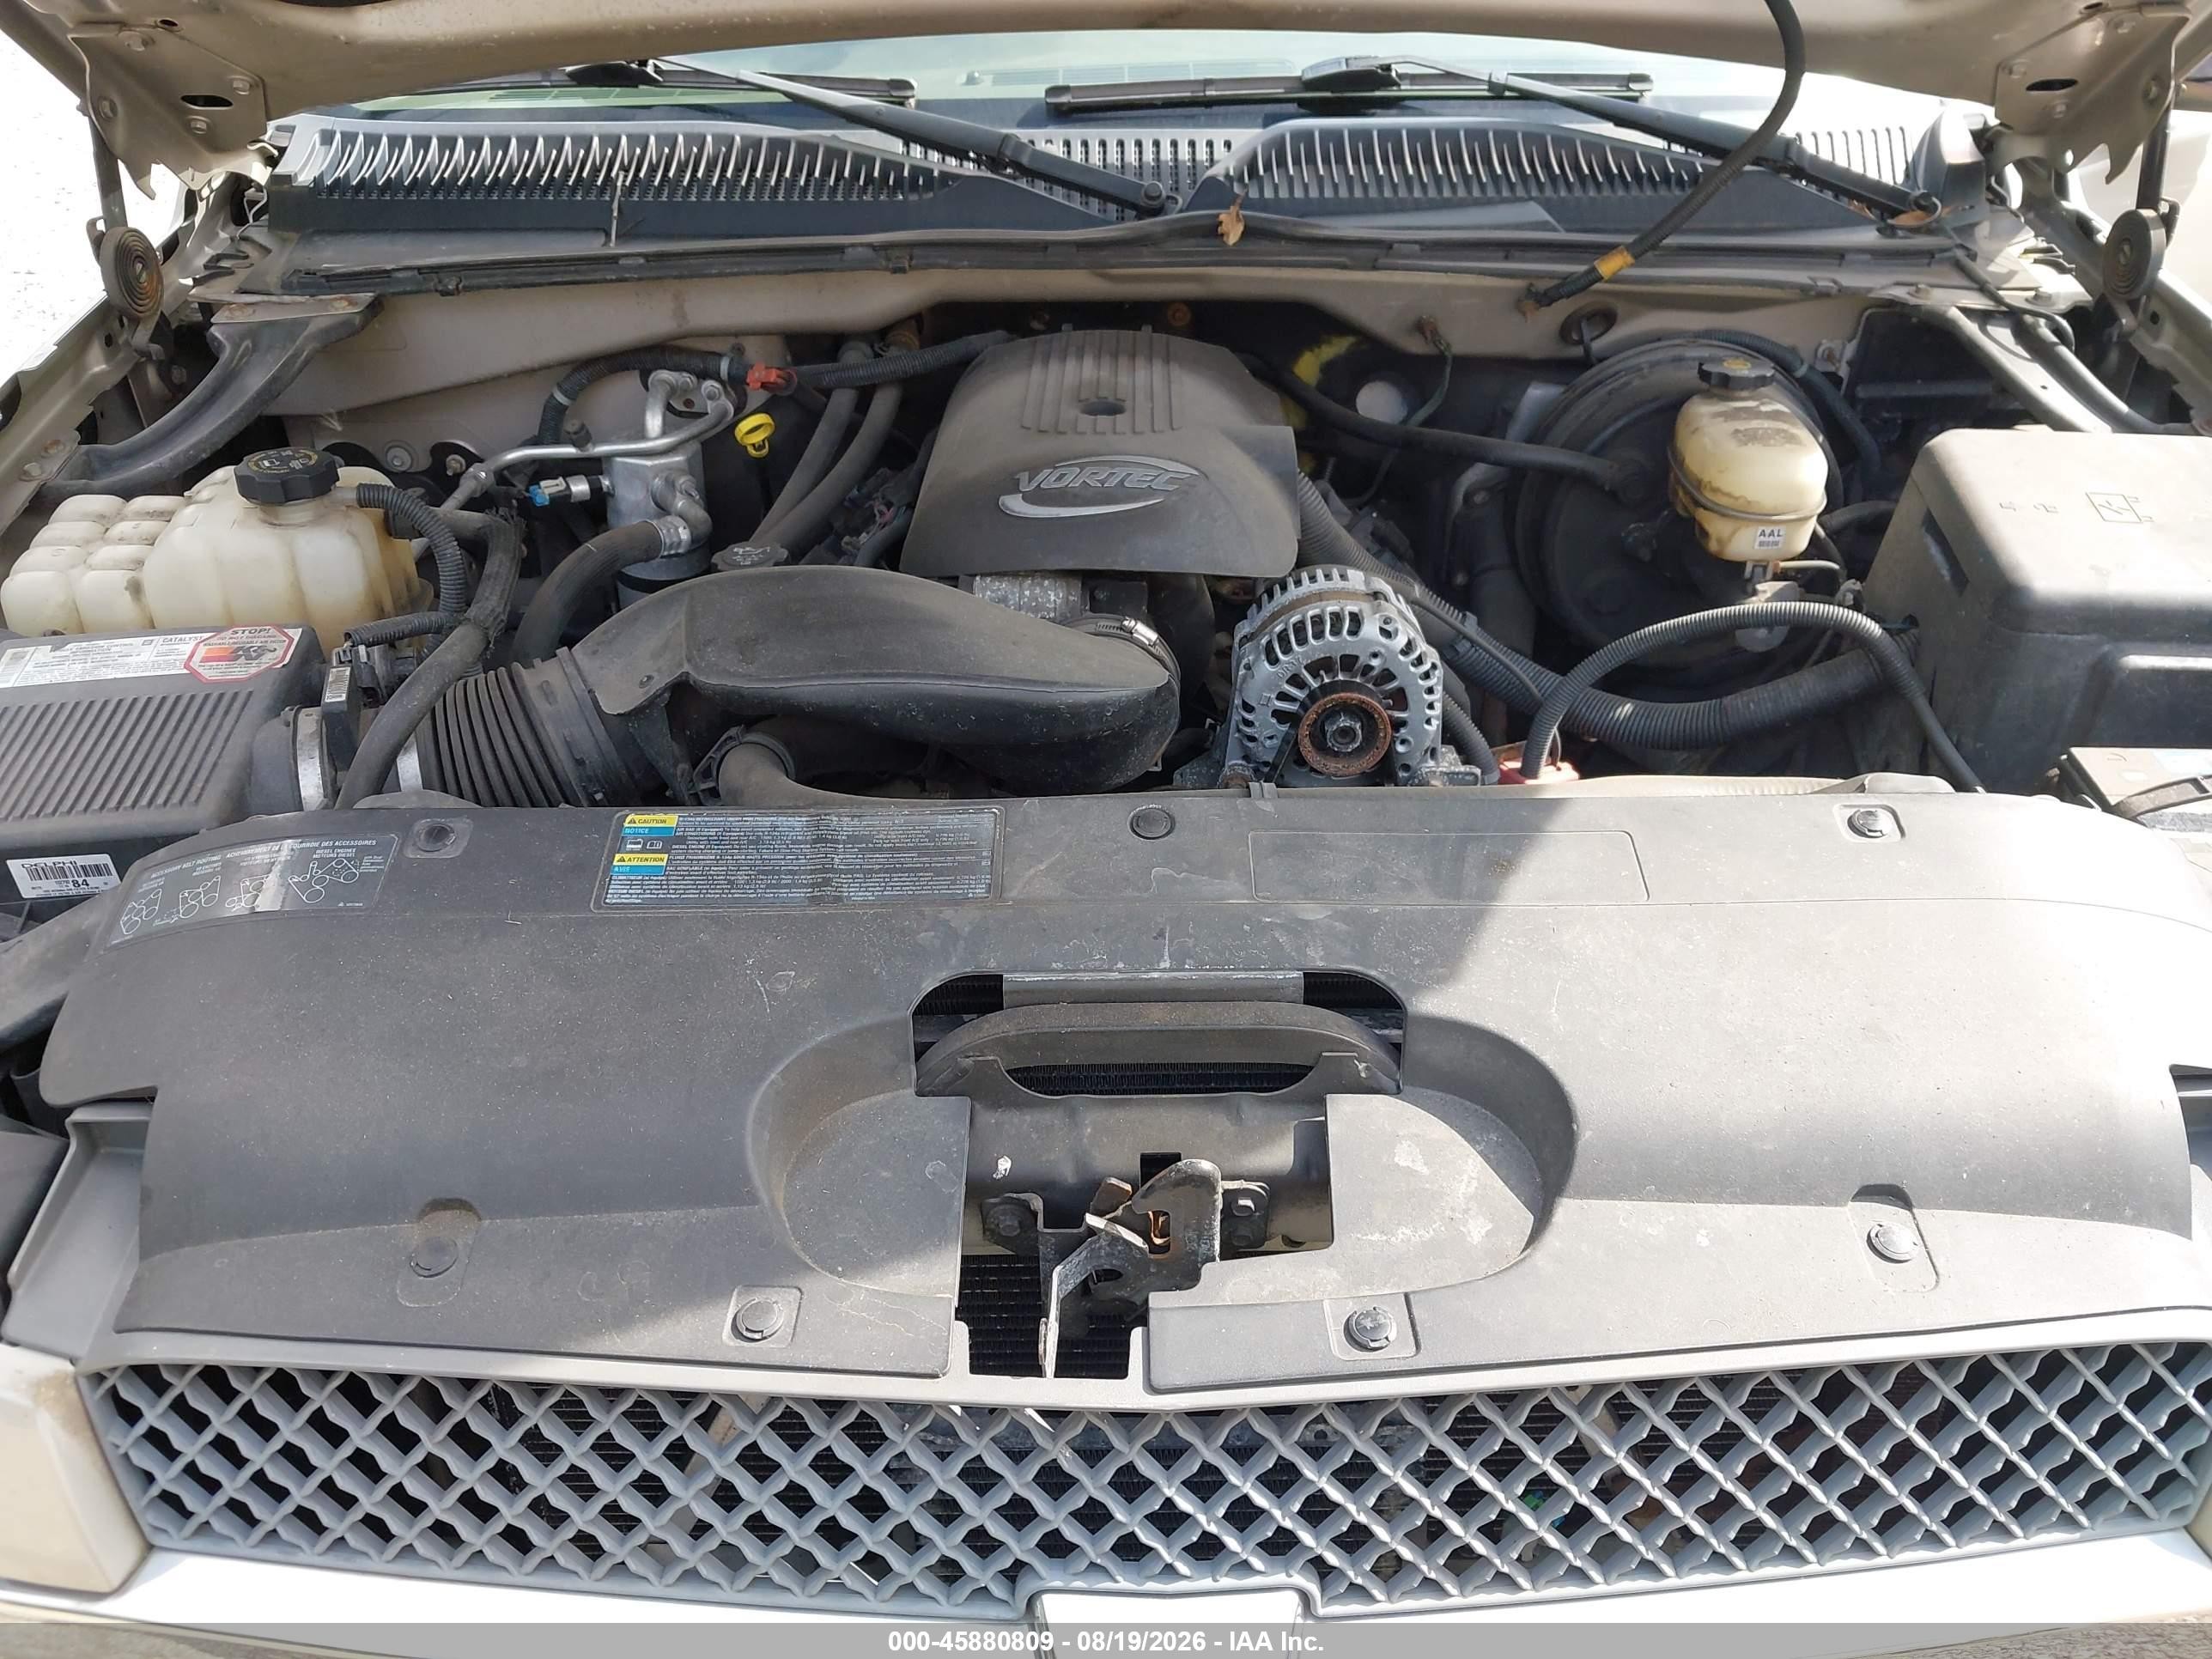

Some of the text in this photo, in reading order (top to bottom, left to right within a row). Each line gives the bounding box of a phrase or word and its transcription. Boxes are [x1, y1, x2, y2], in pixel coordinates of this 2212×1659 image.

[1015, 466, 1191, 491] VORTEC
[1758, 528, 1784, 538] AAL
[71, 879, 89, 888] 84
